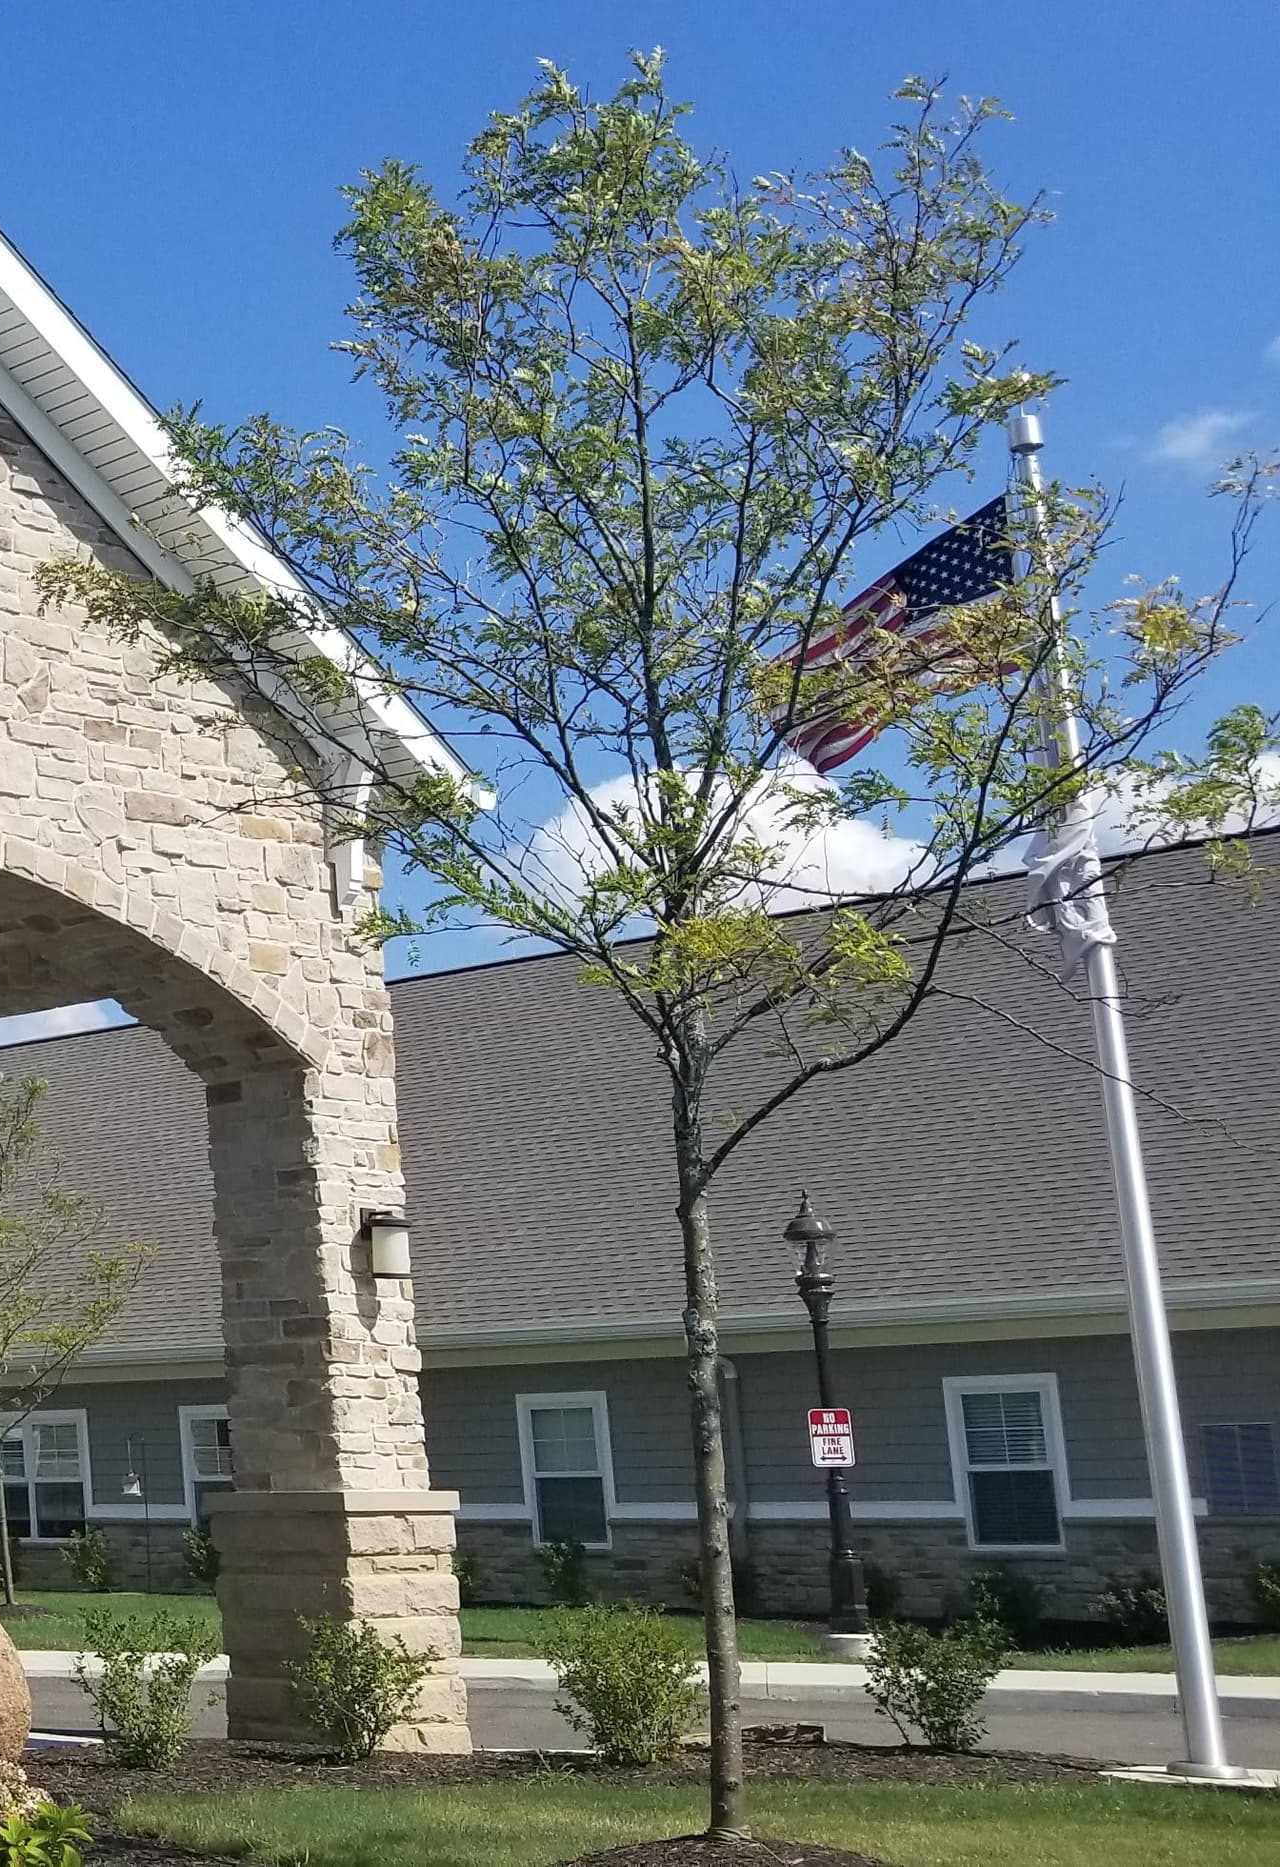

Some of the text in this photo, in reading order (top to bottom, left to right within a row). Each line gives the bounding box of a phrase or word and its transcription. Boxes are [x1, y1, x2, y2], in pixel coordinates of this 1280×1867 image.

[822, 1413, 835, 1423] NO
[811, 1424, 849, 1434] PARKING
[822, 1438, 842, 1446] FIRE
[821, 1446, 844, 1455] LANE
